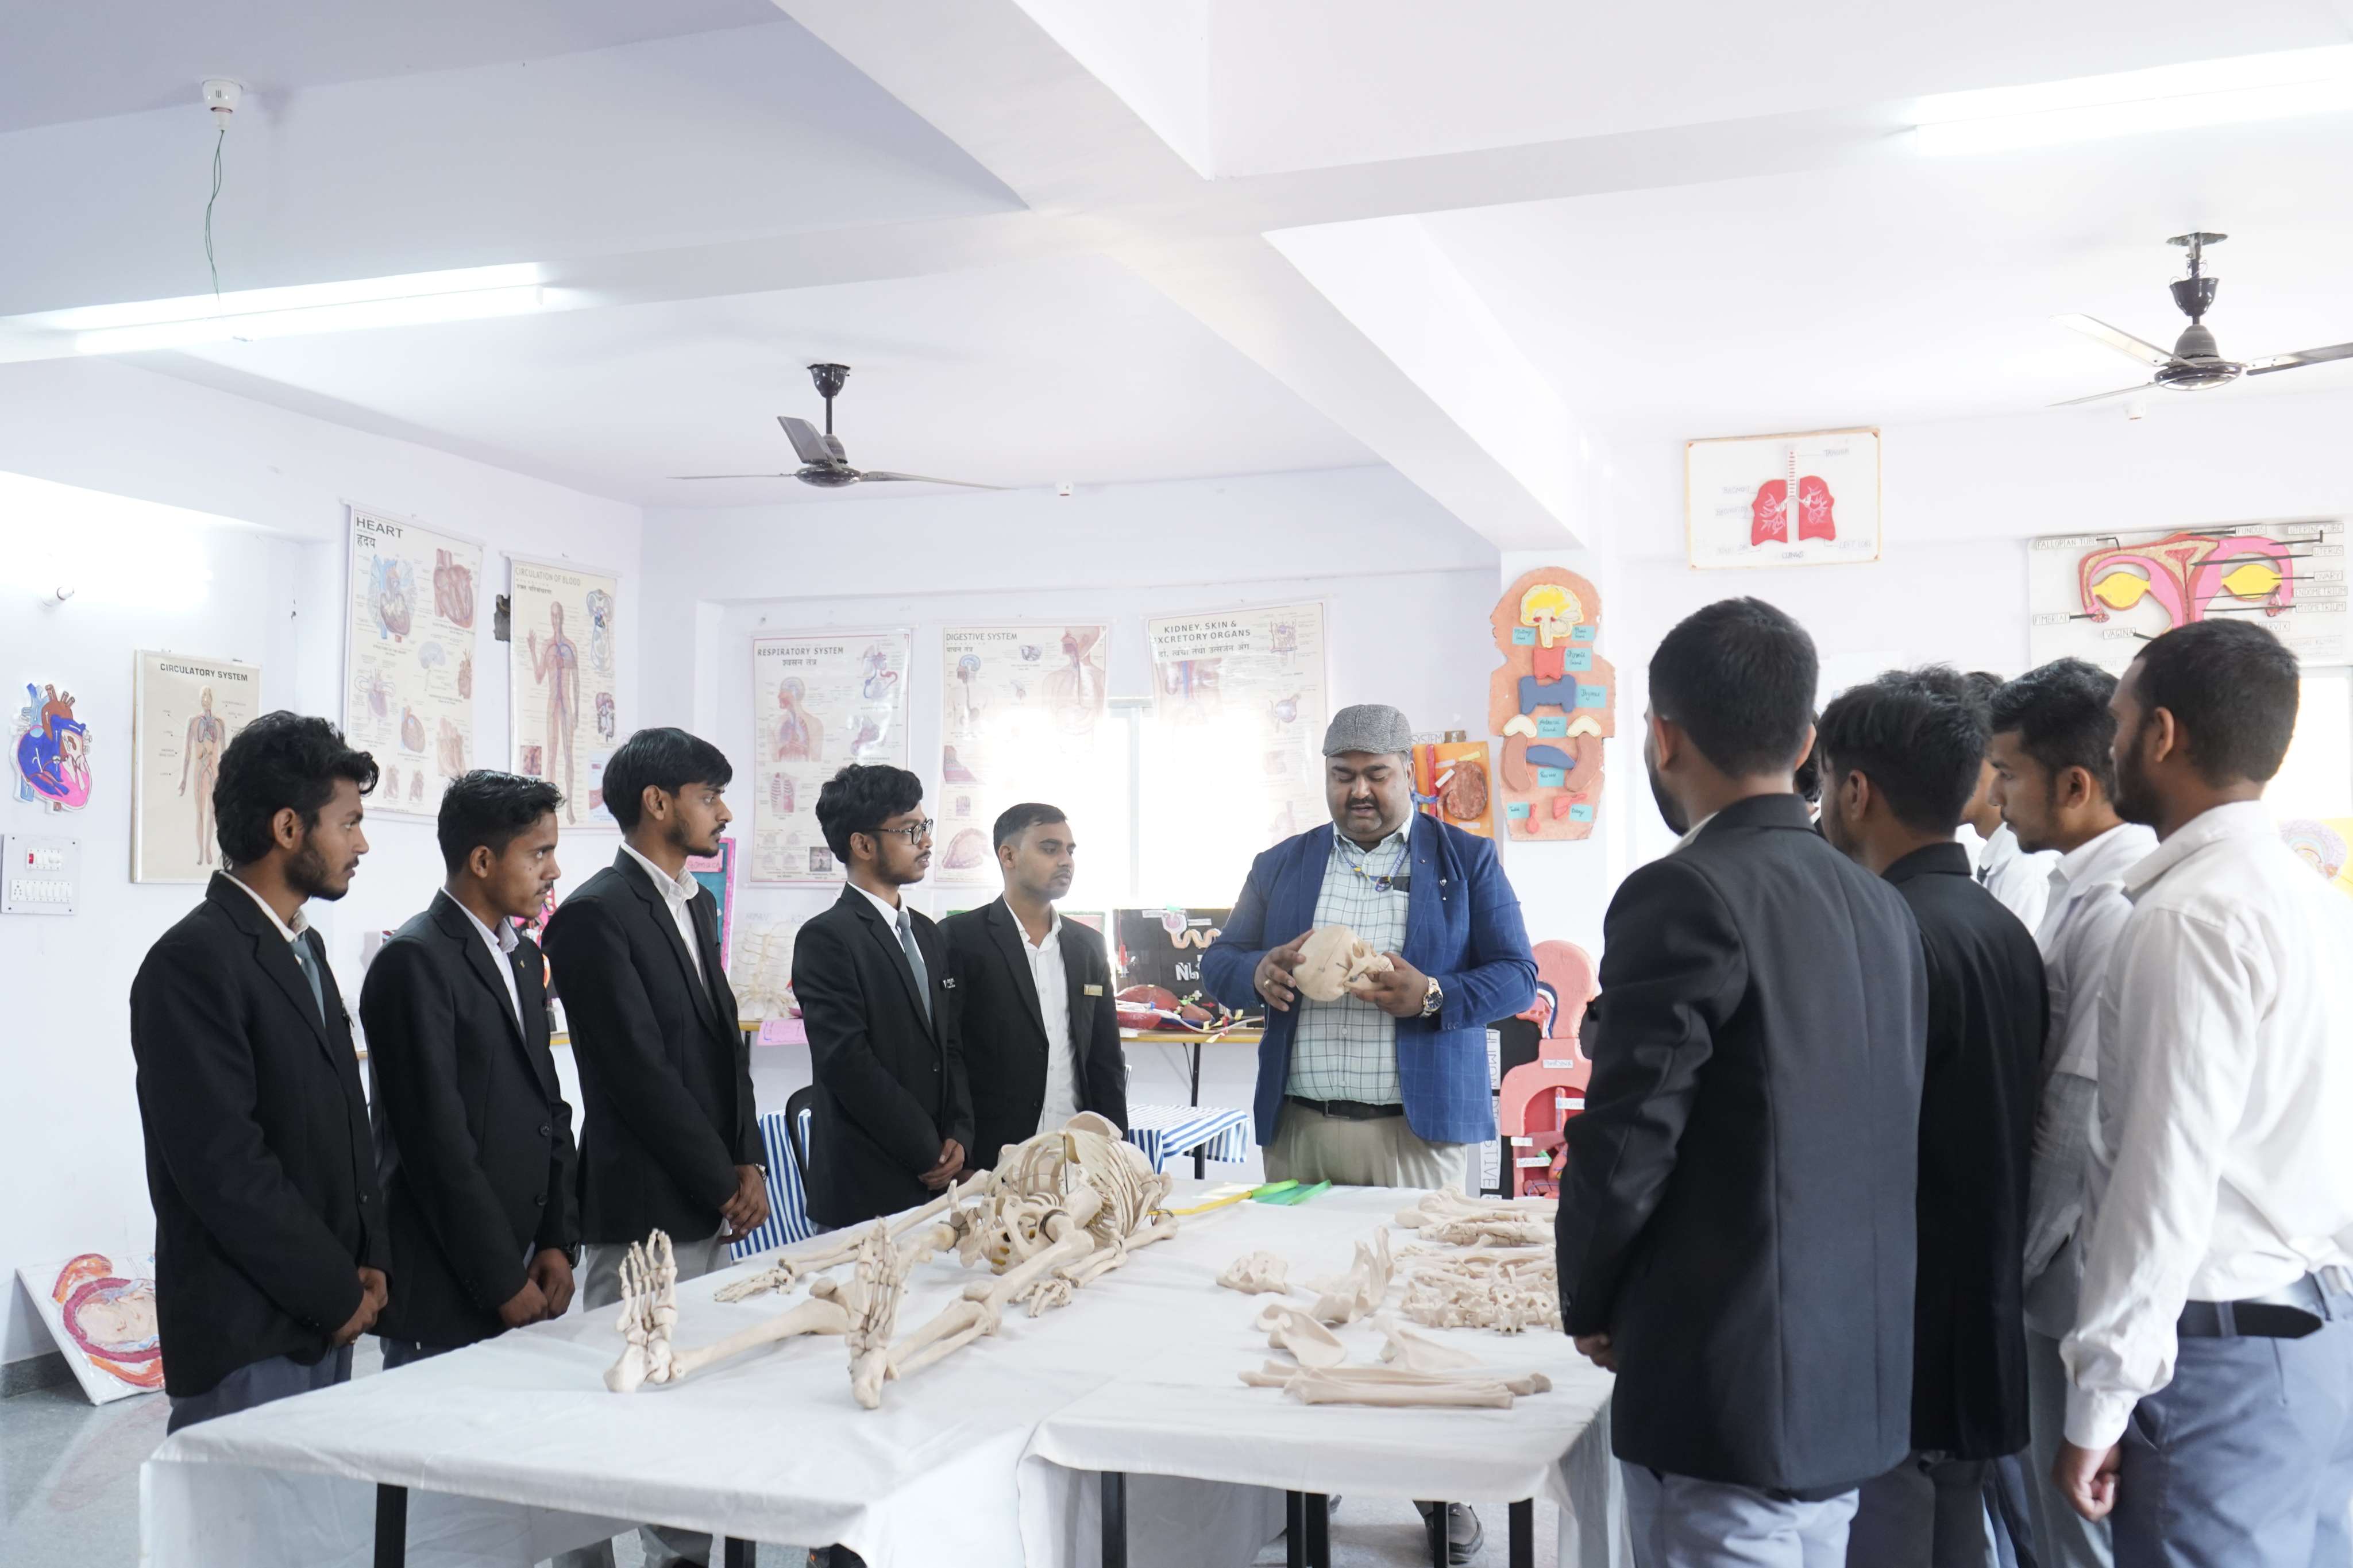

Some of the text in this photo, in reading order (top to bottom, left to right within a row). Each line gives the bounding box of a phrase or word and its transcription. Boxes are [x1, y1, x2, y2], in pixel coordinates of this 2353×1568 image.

[356, 516, 403, 538] HEART
[2237, 526, 2263, 535] FUNDUS
[2290, 525, 2320, 534] UTERIN
[356, 534, 376, 548] हृदय
[2038, 539, 2076, 549] FALLOPIAN
[2315, 546, 2342, 555] UTERUS
[515, 567, 553, 581] CIRCULATION
[562, 576, 581, 586] BLOOD
[2317, 572, 2340, 580] OVARY
[2296, 587, 2346, 596] ENDOMETRIUM
[2298, 603, 2343, 611] MYOMETRIUM
[1164, 623, 1202, 634] KIDNEY,
[1205, 621, 1228, 630] SKIN
[946, 632, 1018, 640] DIGESTIVE SYSTEM
[1210, 629, 1251, 639] ORGANS
[2106, 628, 2134, 638] VAGINA
[757, 646, 844, 656] RESPIRATORY SYSTEM
[160, 663, 248, 682] CIRCULATORY SYSTEM
[1411, 733, 1443, 744] SYSTEM
